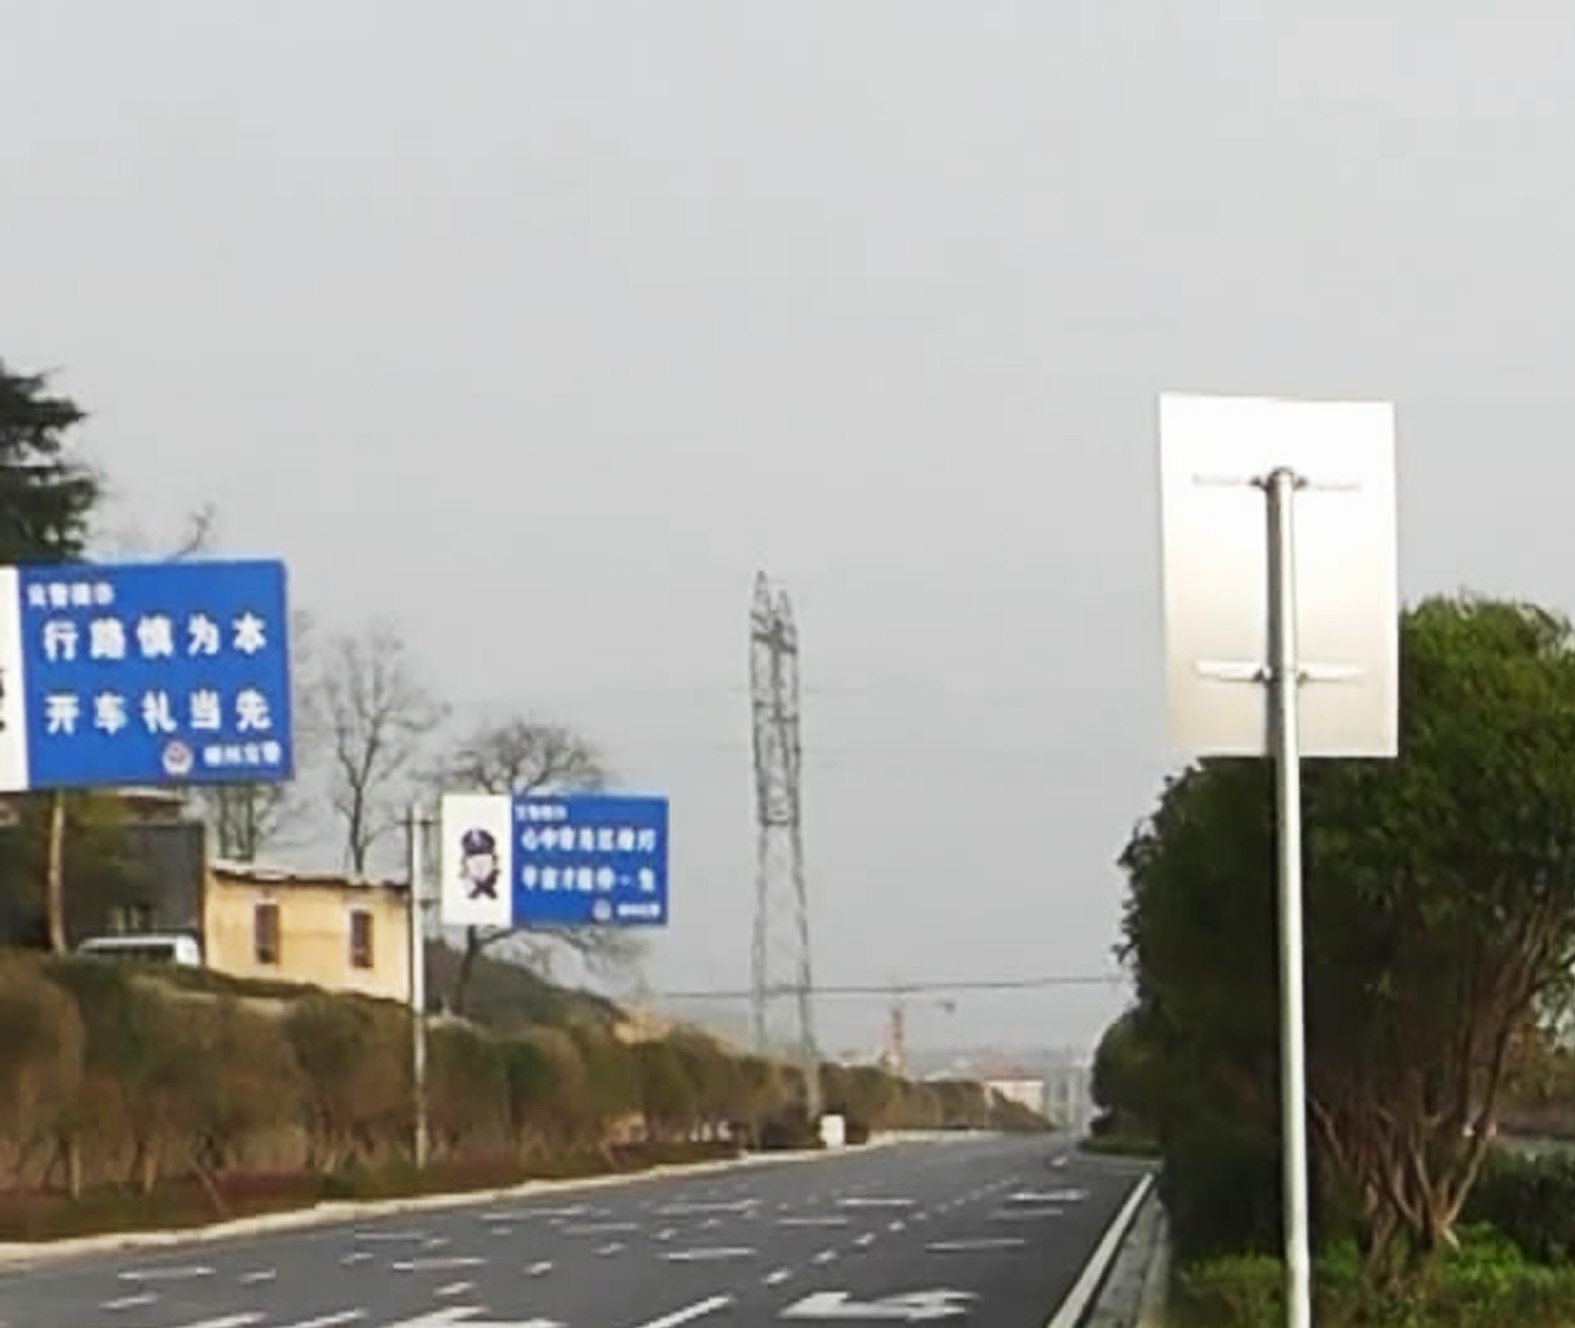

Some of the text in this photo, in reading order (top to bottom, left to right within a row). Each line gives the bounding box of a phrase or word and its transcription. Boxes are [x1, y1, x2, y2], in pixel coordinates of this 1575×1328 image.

[44, 612, 266, 661] 行路慎为本
[45, 689, 272, 734] 开车礼当先
